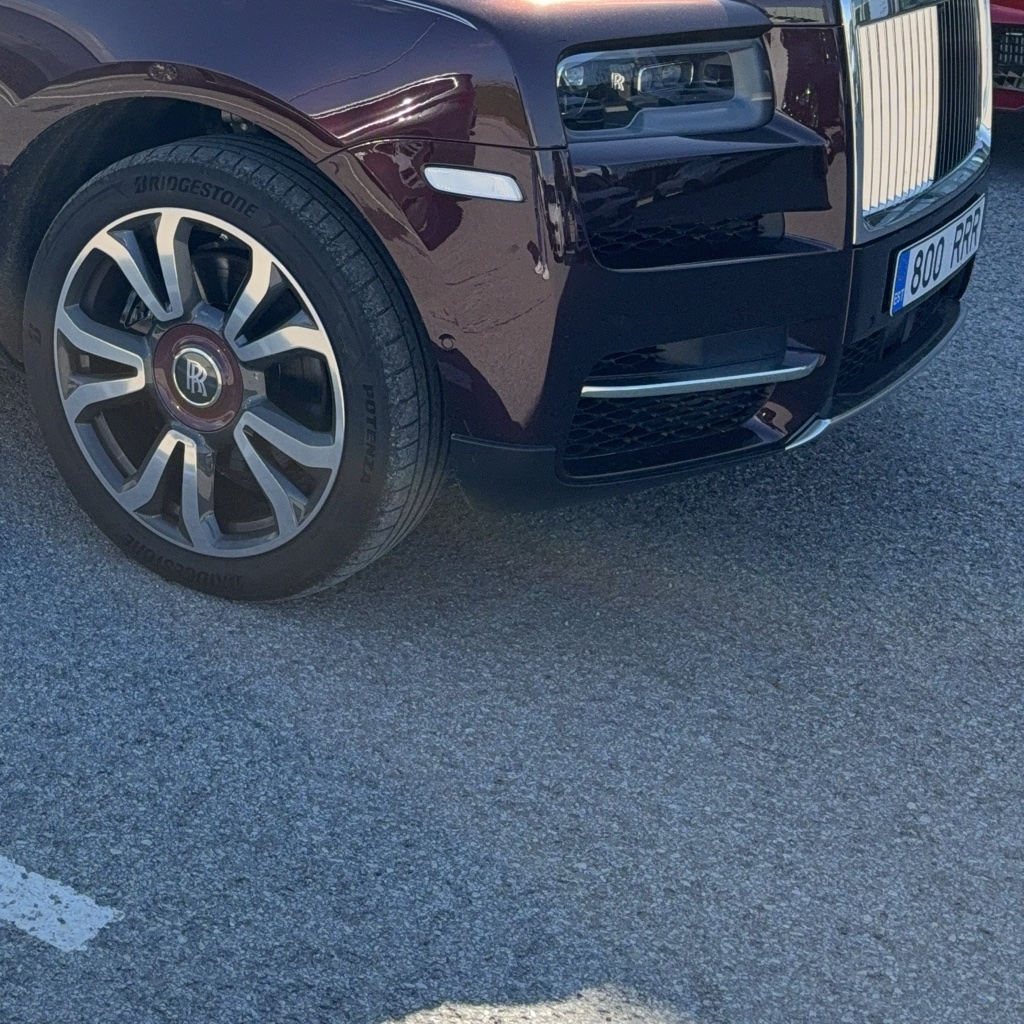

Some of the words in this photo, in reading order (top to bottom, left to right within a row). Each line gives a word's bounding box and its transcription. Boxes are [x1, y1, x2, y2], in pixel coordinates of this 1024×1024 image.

[611, 72, 625, 91] RR
[134, 175, 259, 218] BRIDGESTONE
[910, 236, 945, 295] 800
[950, 206, 981, 269] RRR
[893, 288, 905, 306] EST
[186, 359, 208, 397] RR
[360, 383, 376, 484] POTENZA
